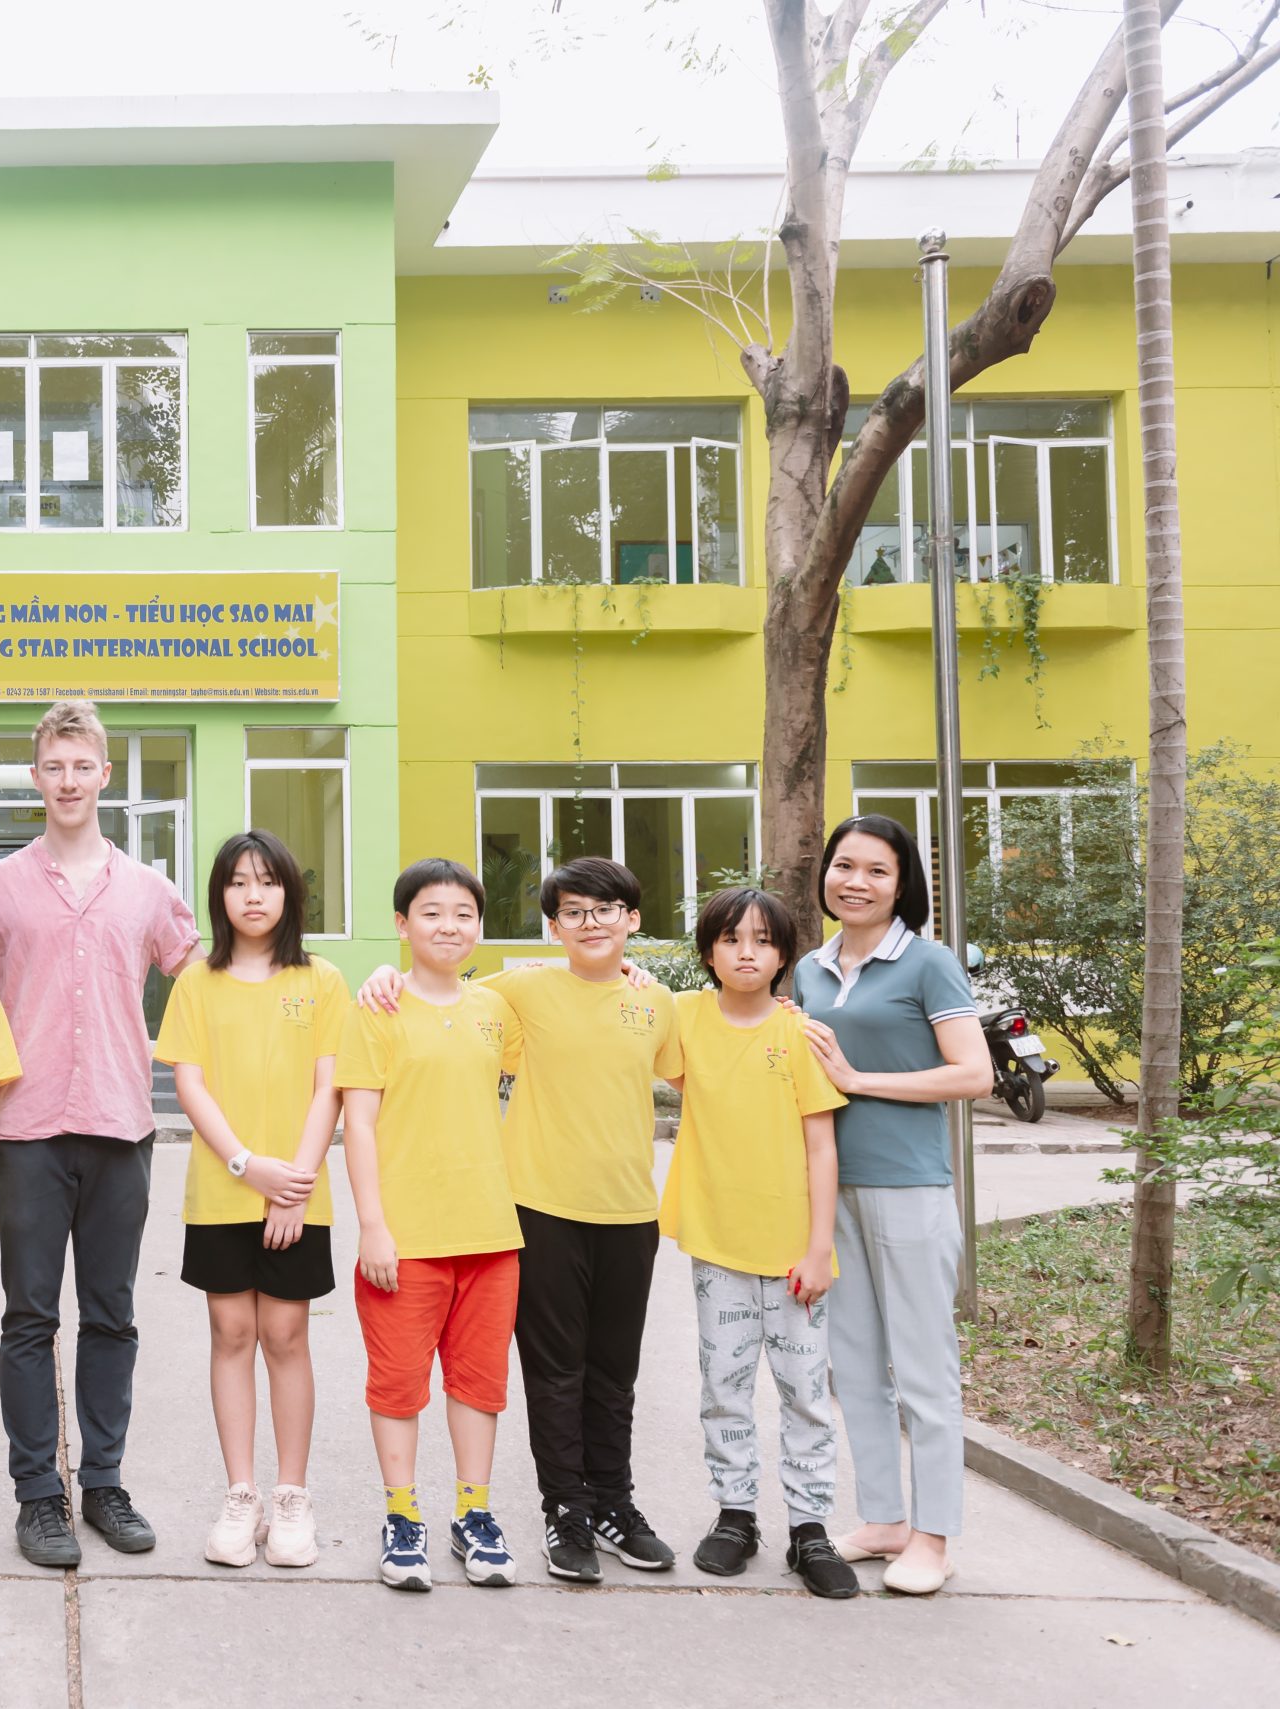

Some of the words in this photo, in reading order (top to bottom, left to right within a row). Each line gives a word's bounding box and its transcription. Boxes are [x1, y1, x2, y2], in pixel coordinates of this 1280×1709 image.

[11, 595, 60, 624] MẦM
[64, 604, 108, 624] NON
[125, 595, 175, 624] TIỂU
[180, 604, 225, 628] HỌC
[229, 603, 270, 624] SAO
[274, 603, 314, 623] MAI
[18, 638, 69, 658] STAR
[73, 638, 234, 658] INTERNATIONAL
[237, 638, 318, 658] SCHOOL
[55, 687, 86, 697] Facebook:
[129, 687, 148, 697] Email:
[254, 687, 281, 697] Website:
[777, 1338, 818, 1355] SEEKER
